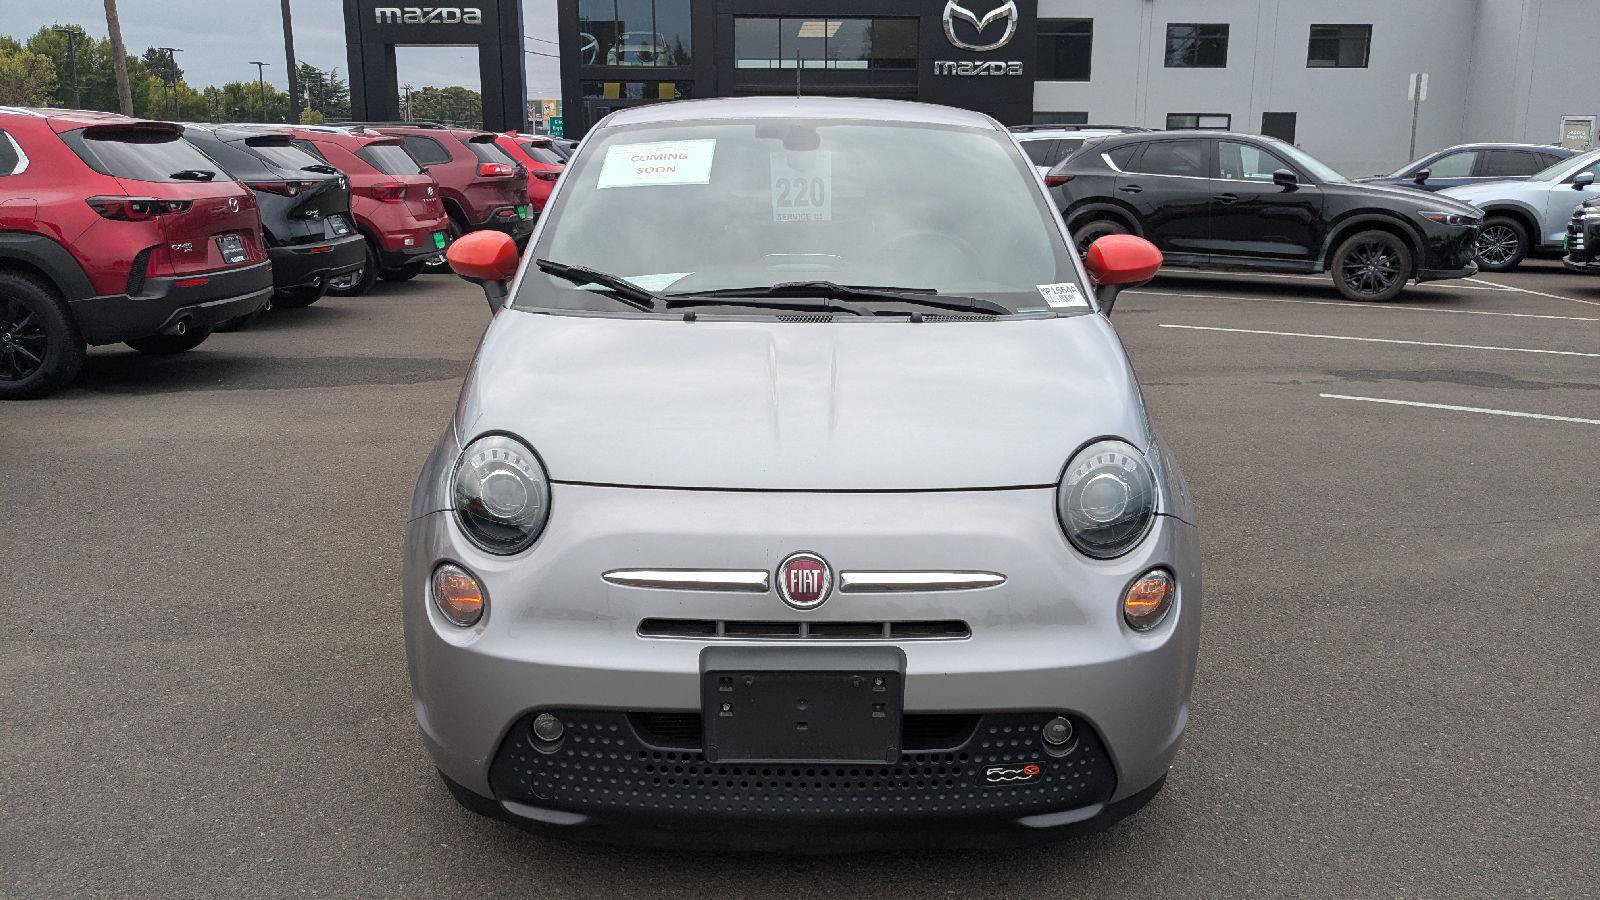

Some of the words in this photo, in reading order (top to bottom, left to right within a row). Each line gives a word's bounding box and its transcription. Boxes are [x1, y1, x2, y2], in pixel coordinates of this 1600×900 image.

[375, 7, 482, 24] mazda
[934, 61, 1023, 76] mazda
[631, 153, 688, 162] COMING
[637, 166, 676, 175] SOON
[776, 177, 825, 208] 220
[790, 569, 821, 593] FIAT
